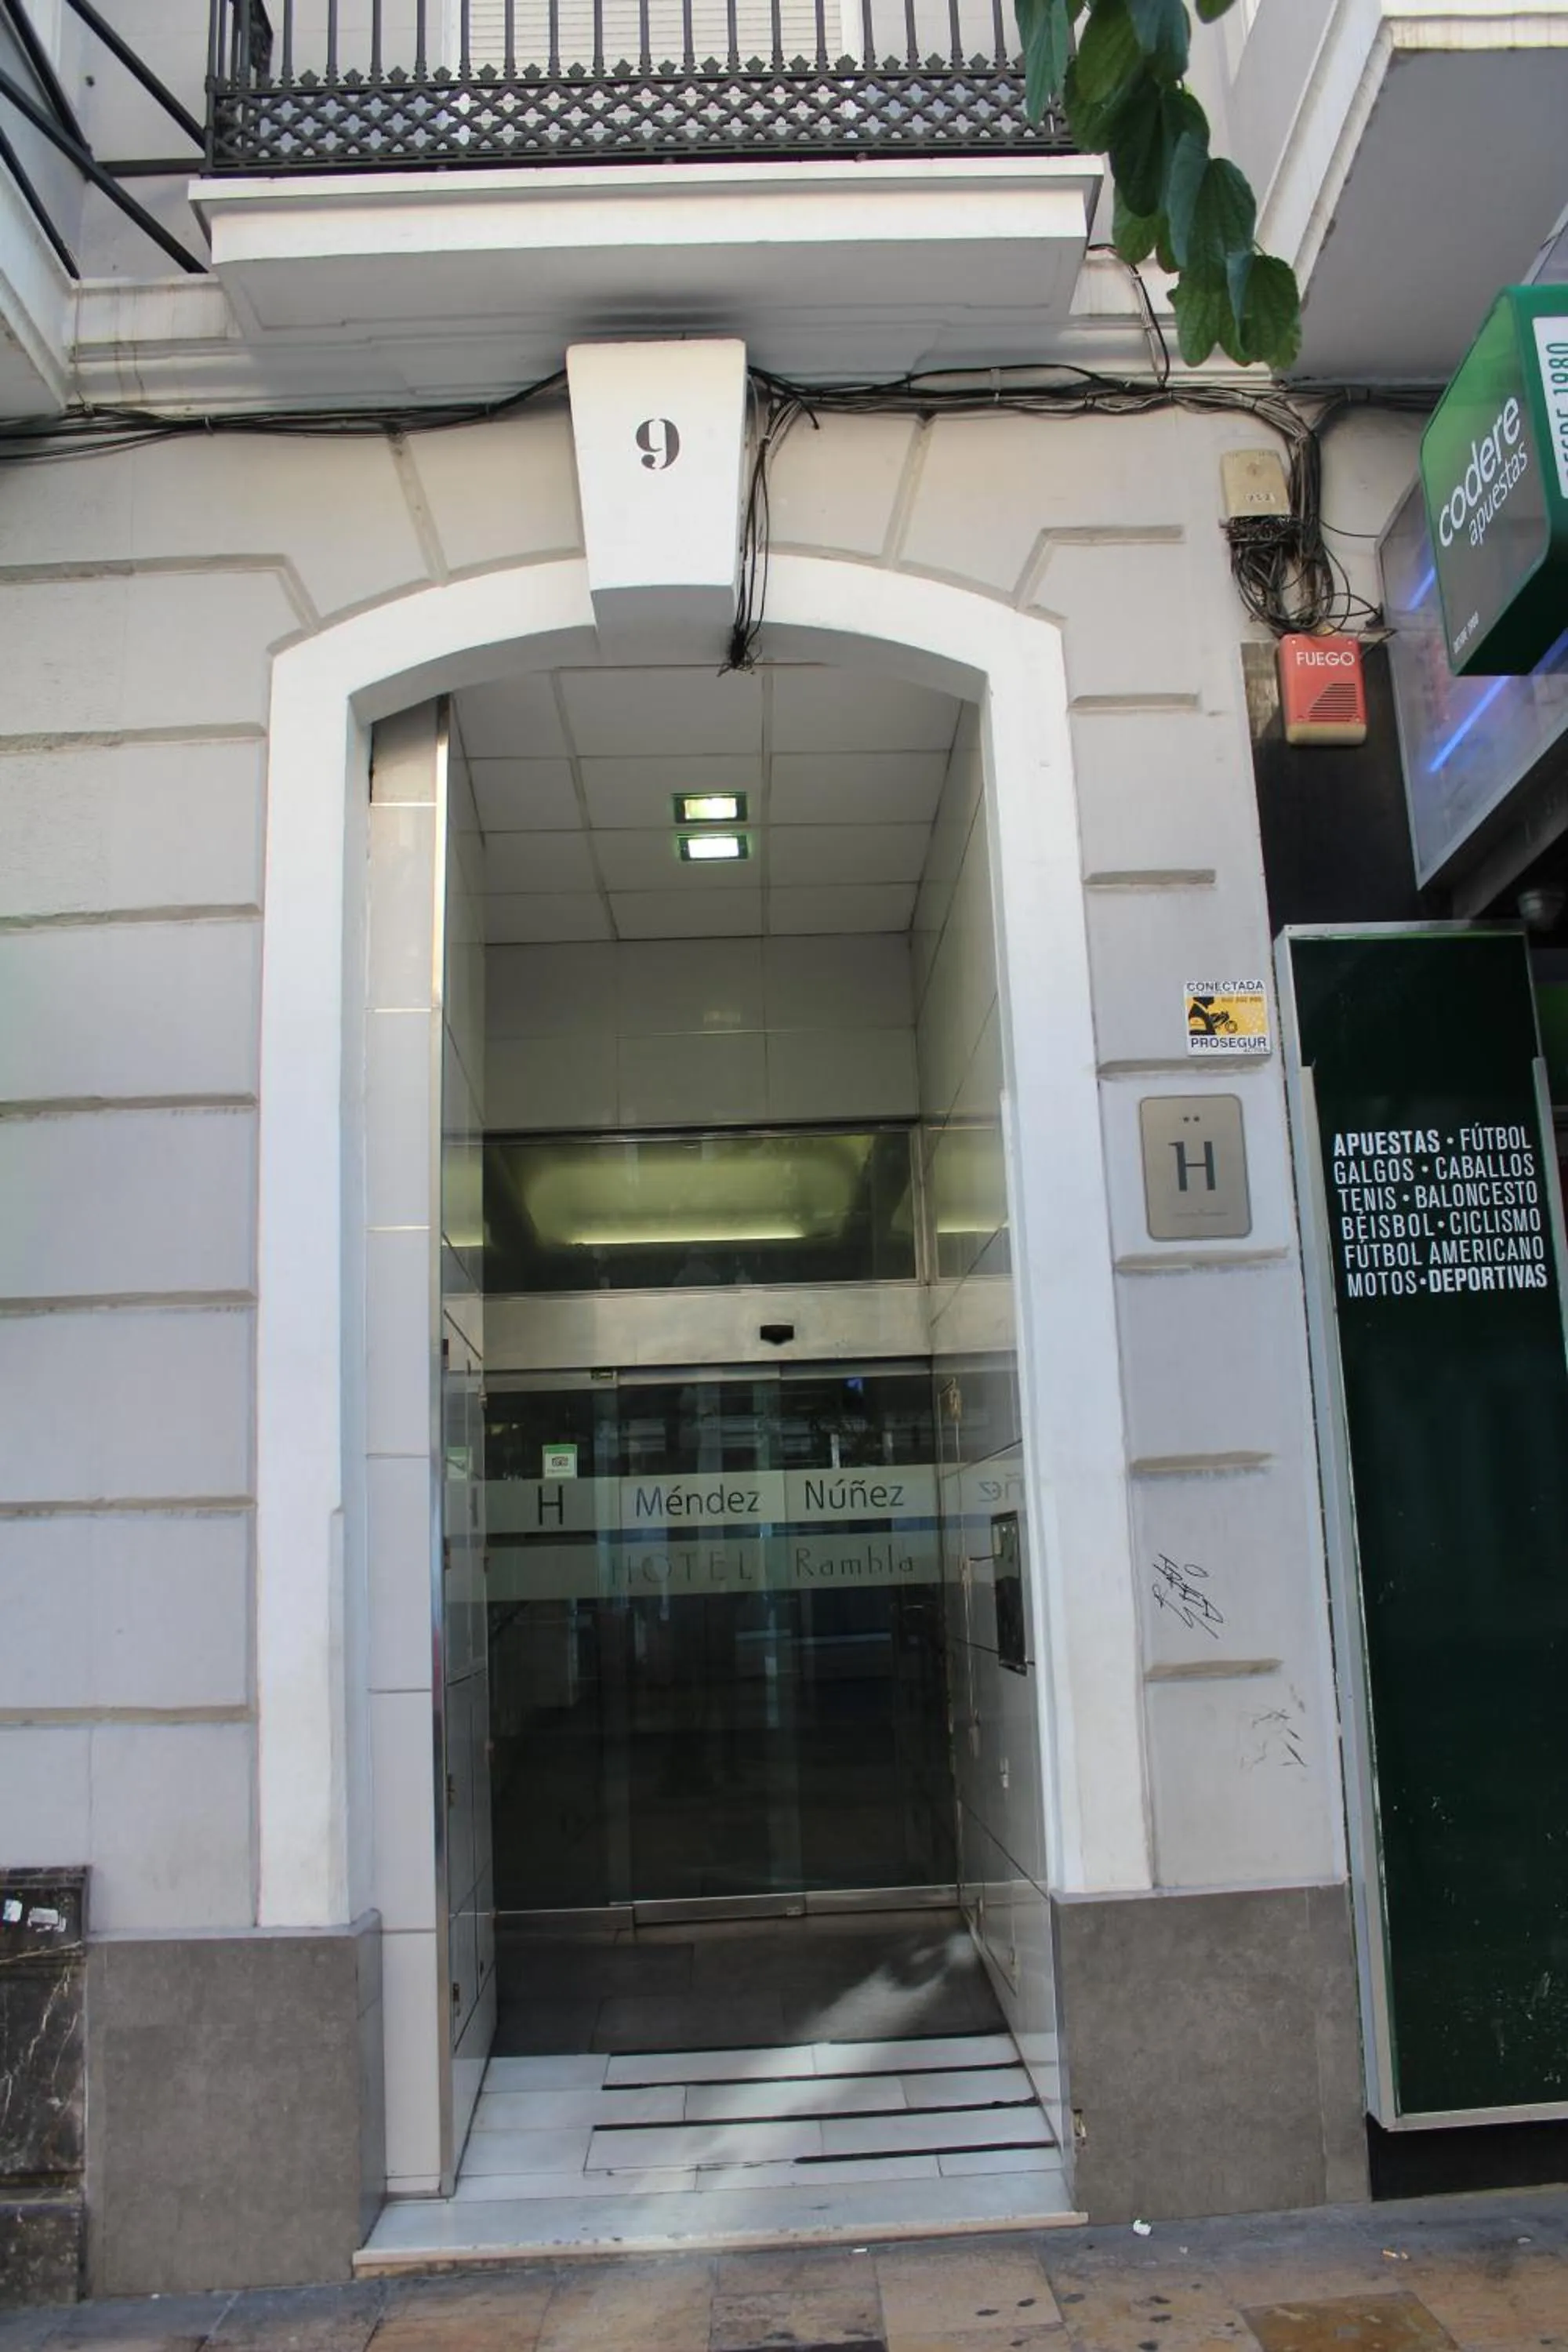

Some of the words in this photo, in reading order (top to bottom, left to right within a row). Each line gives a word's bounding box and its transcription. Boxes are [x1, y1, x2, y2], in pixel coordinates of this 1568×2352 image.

[635, 418, 681, 470] 9
[1438, 396, 1521, 548] codere
[1467, 441, 1528, 546] apuestas
[1295, 651, 1356, 666] FUEGO
[1186, 980, 1265, 992] CONECTADA
[1191, 1036, 1267, 1048] PROSEGUR
[1334, 1129, 1441, 1156] APUESTAS
[1460, 1122, 1532, 1151] FÚTBOL
[1334, 1158, 1414, 1185] GALGOS
[1436, 1153, 1534, 1180] CABALLOS
[1338, 1186, 1396, 1213] TENIS
[1414, 1180, 1537, 1210] BALONCESTO
[1341, 1210, 1435, 1241] BÉISBOL
[1450, 1208, 1541, 1236] CICLISMO
[1344, 1238, 1422, 1269] FÚTBOL
[1429, 1236, 1544, 1265] AMERICANO
[1346, 1271, 1417, 1298] MOTOS
[1428, 1263, 1548, 1294] DEPORTIVAS
[538, 1484, 564, 1526] H
[635, 1484, 760, 1518] Méndez
[804, 1479, 905, 1511] Núñez
[612, 1549, 753, 1586] HOTEL
[795, 1545, 914, 1578] Rambla
